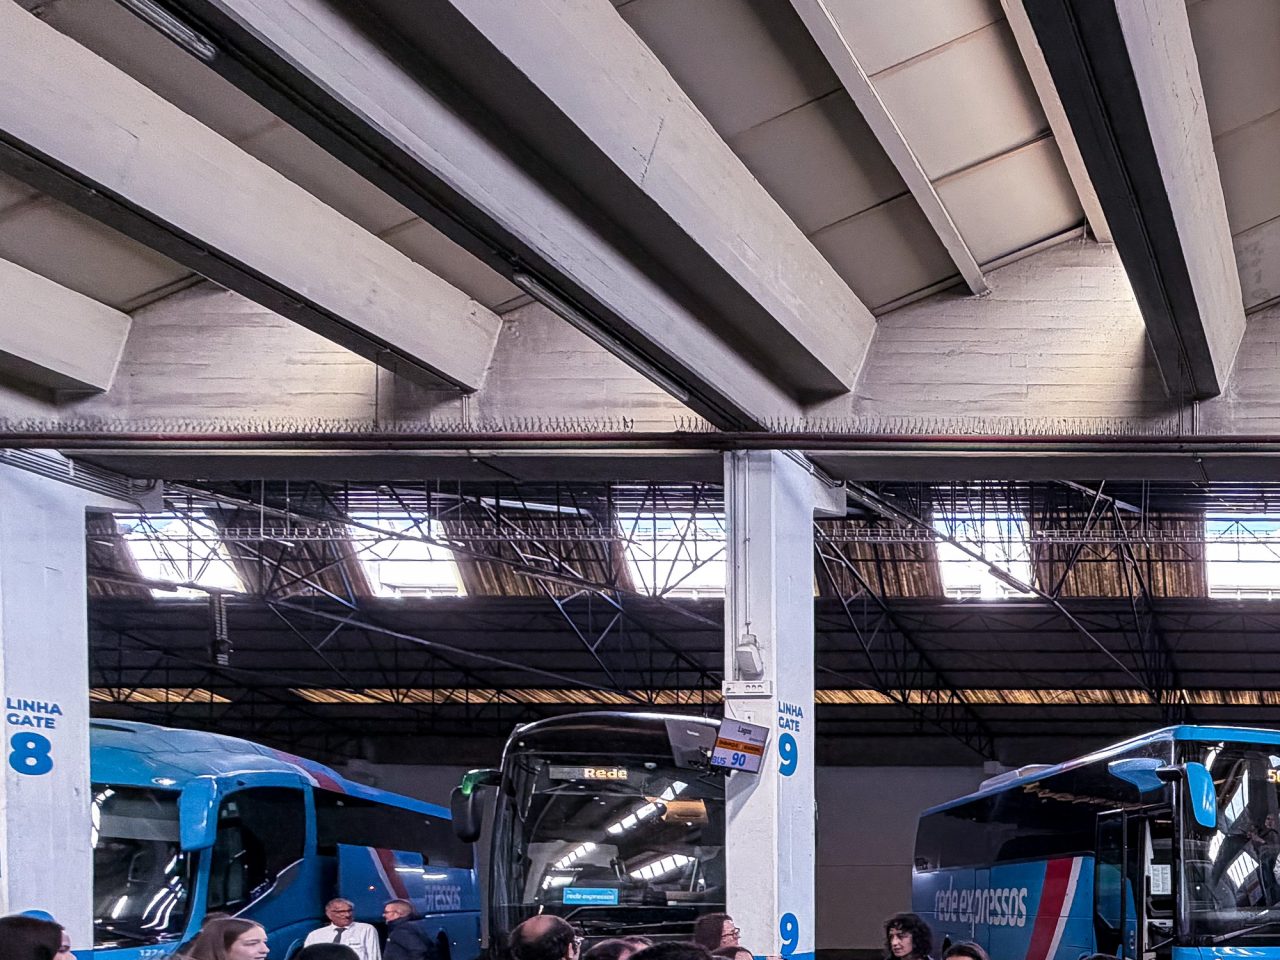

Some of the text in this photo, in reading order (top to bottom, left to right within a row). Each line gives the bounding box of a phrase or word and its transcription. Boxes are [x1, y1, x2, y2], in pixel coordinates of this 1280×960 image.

[6, 697, 63, 716] LINHA
[778, 701, 804, 719] LINHA
[6, 713, 56, 729] GATE
[778, 716, 800, 732] GATE
[9, 732, 54, 776] 8
[731, 752, 747, 767] 90
[778, 732, 798, 777] 9
[584, 768, 628, 780] Rede
[780, 912, 799, 960] 9
